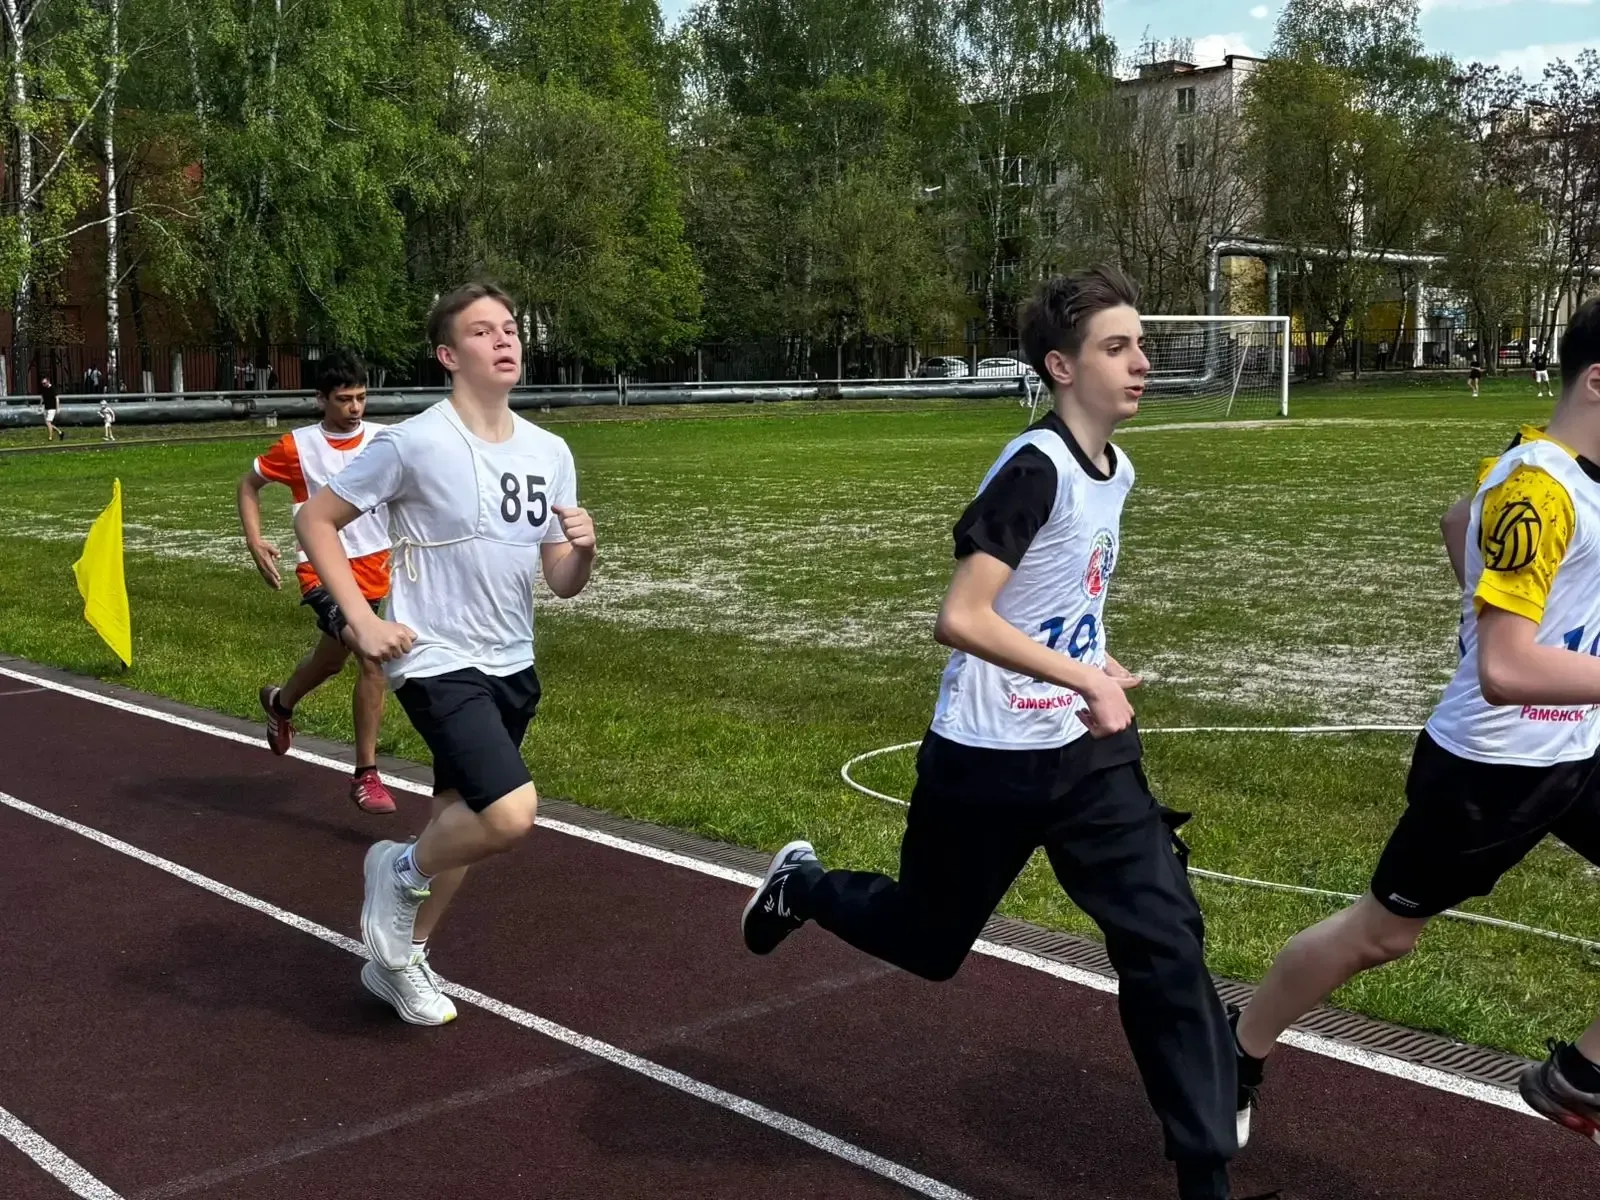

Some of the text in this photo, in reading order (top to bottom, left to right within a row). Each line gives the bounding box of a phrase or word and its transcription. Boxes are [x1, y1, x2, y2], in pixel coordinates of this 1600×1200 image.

[500, 472, 548, 527] 85
[1010, 692, 1079, 710] Раменска
[1520, 704, 1590, 722] Раменск
